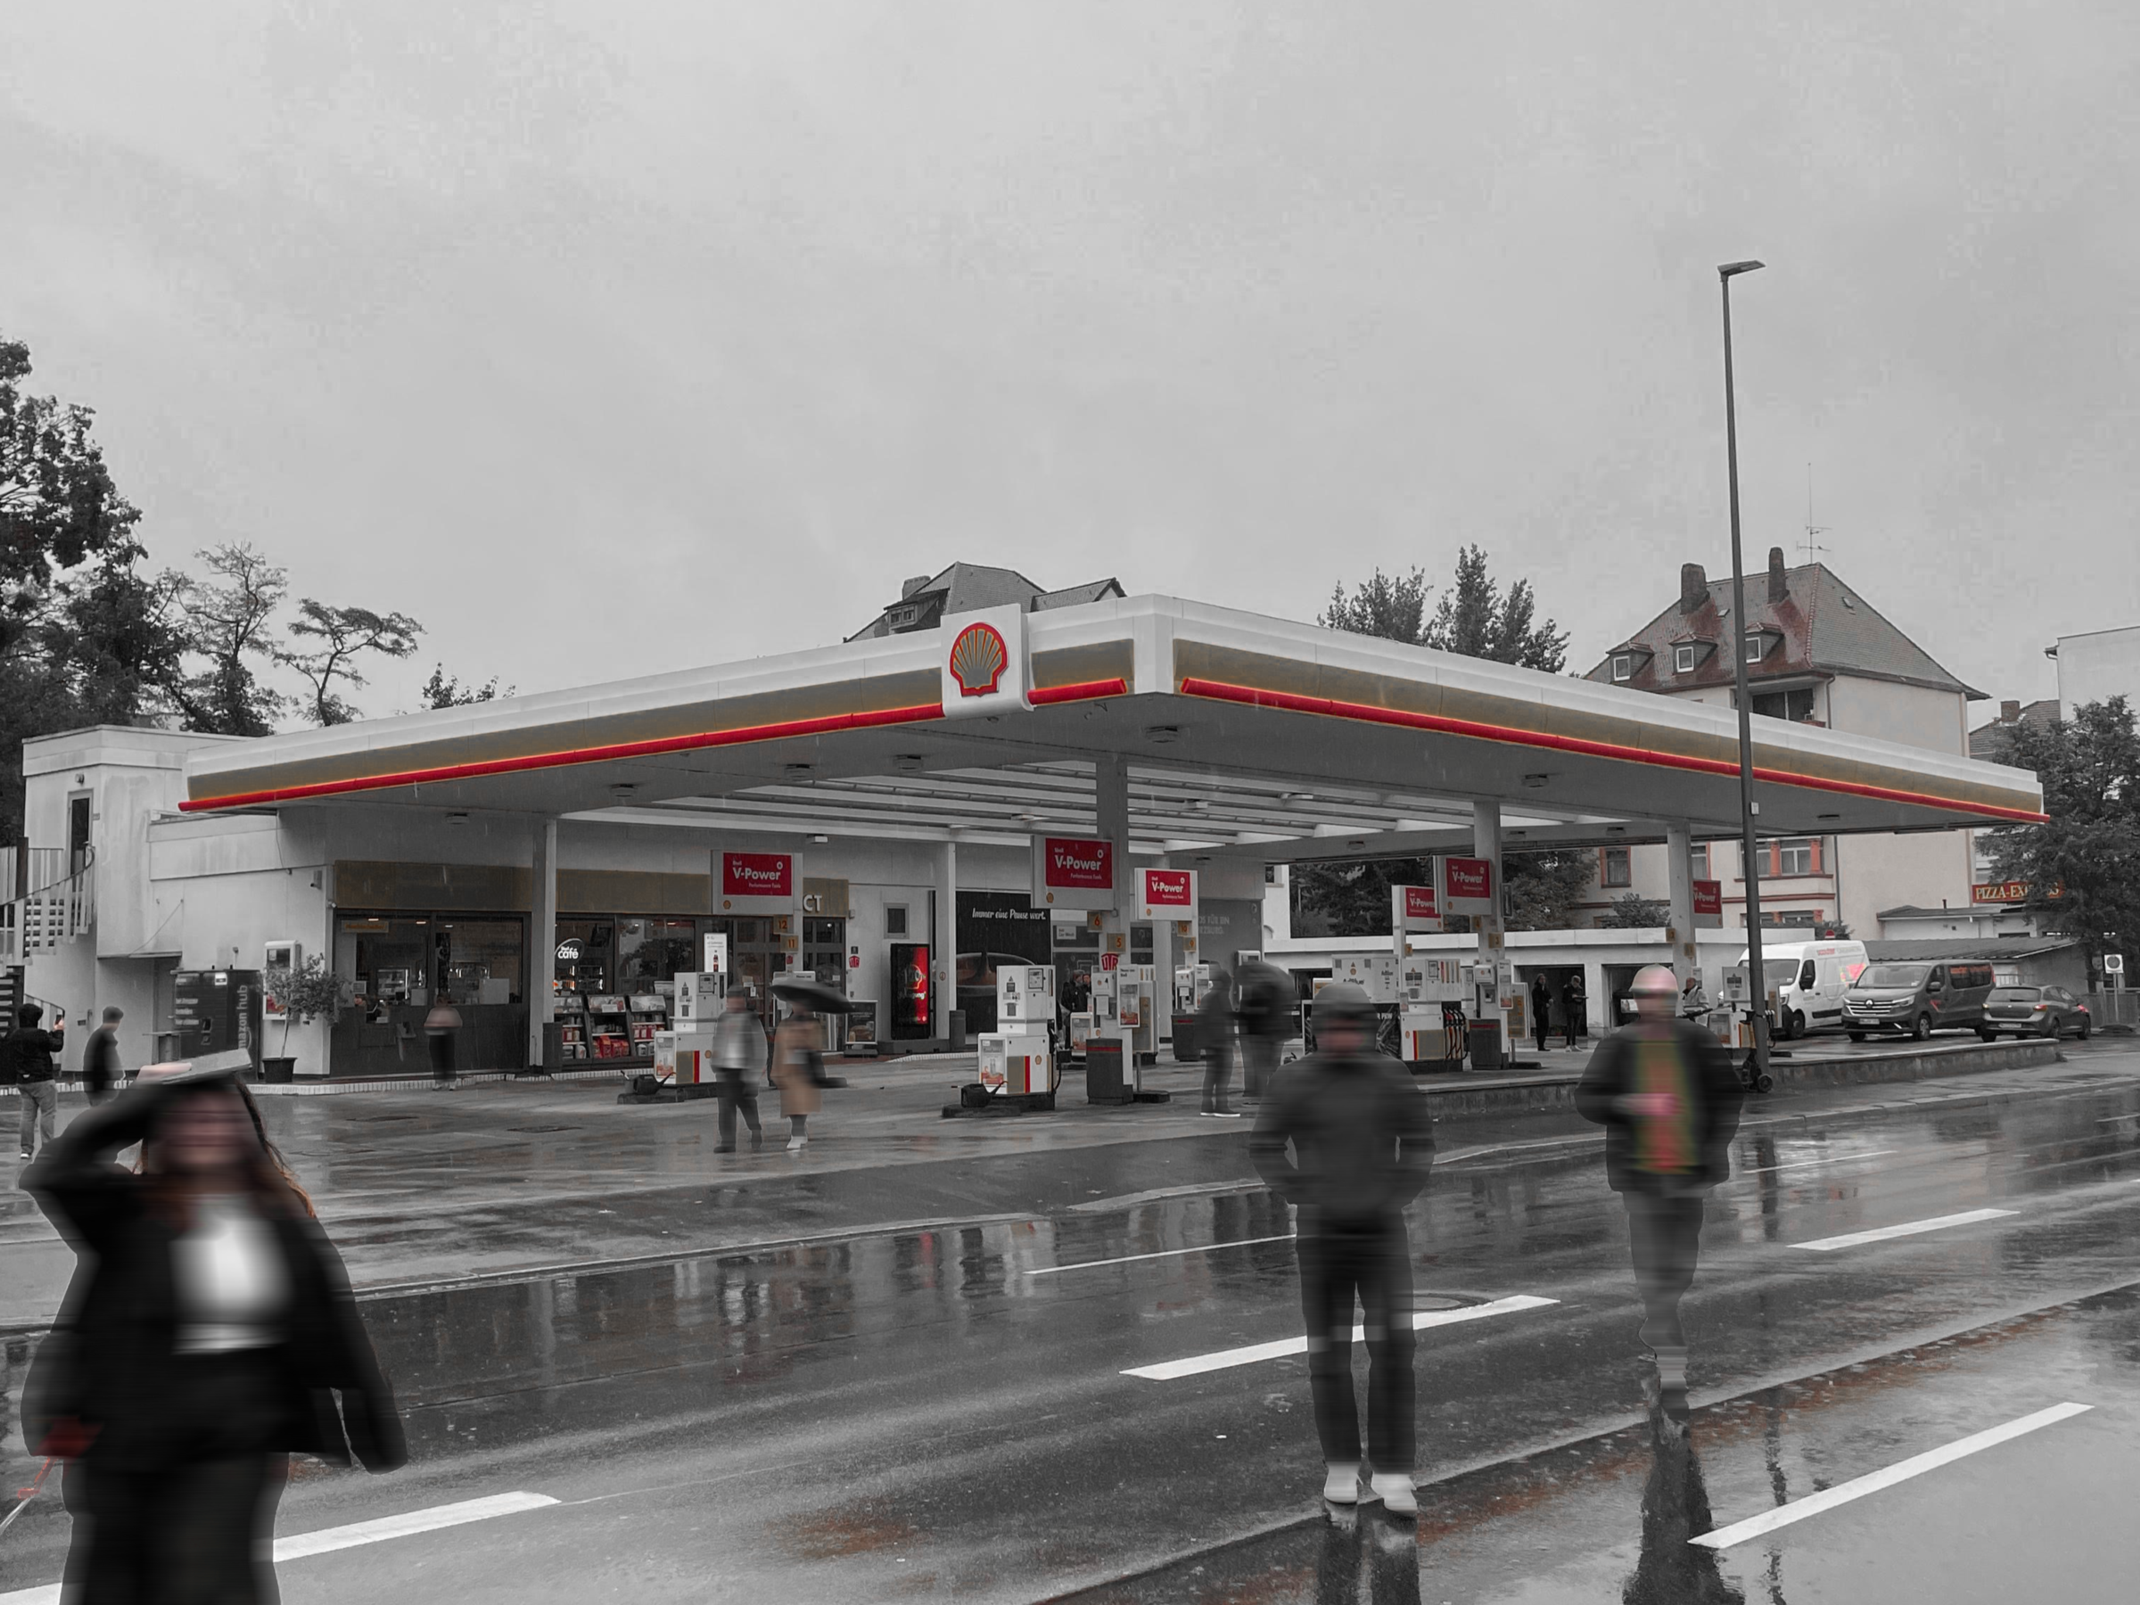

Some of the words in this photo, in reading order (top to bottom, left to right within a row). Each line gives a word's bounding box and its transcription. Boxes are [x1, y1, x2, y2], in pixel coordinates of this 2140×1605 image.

[1054, 855, 1101, 870] V-Power
[732, 867, 781, 880] V-Power
[1452, 870, 1483, 884] V-Power
[1151, 881, 1183, 893] V-Power
[1975, 884, 2060, 900] PIZZA-EXSS
[1410, 897, 1435, 908] V-Powe
[778, 920, 788, 929] 12
[1094, 915, 1100, 926] 6
[788, 938, 795, 948] 11
[1116, 936, 1122, 948] 5
[557, 947, 579, 959] café
[236, 985, 248, 1010] hub
[237, 1012, 248, 1050] mazon
